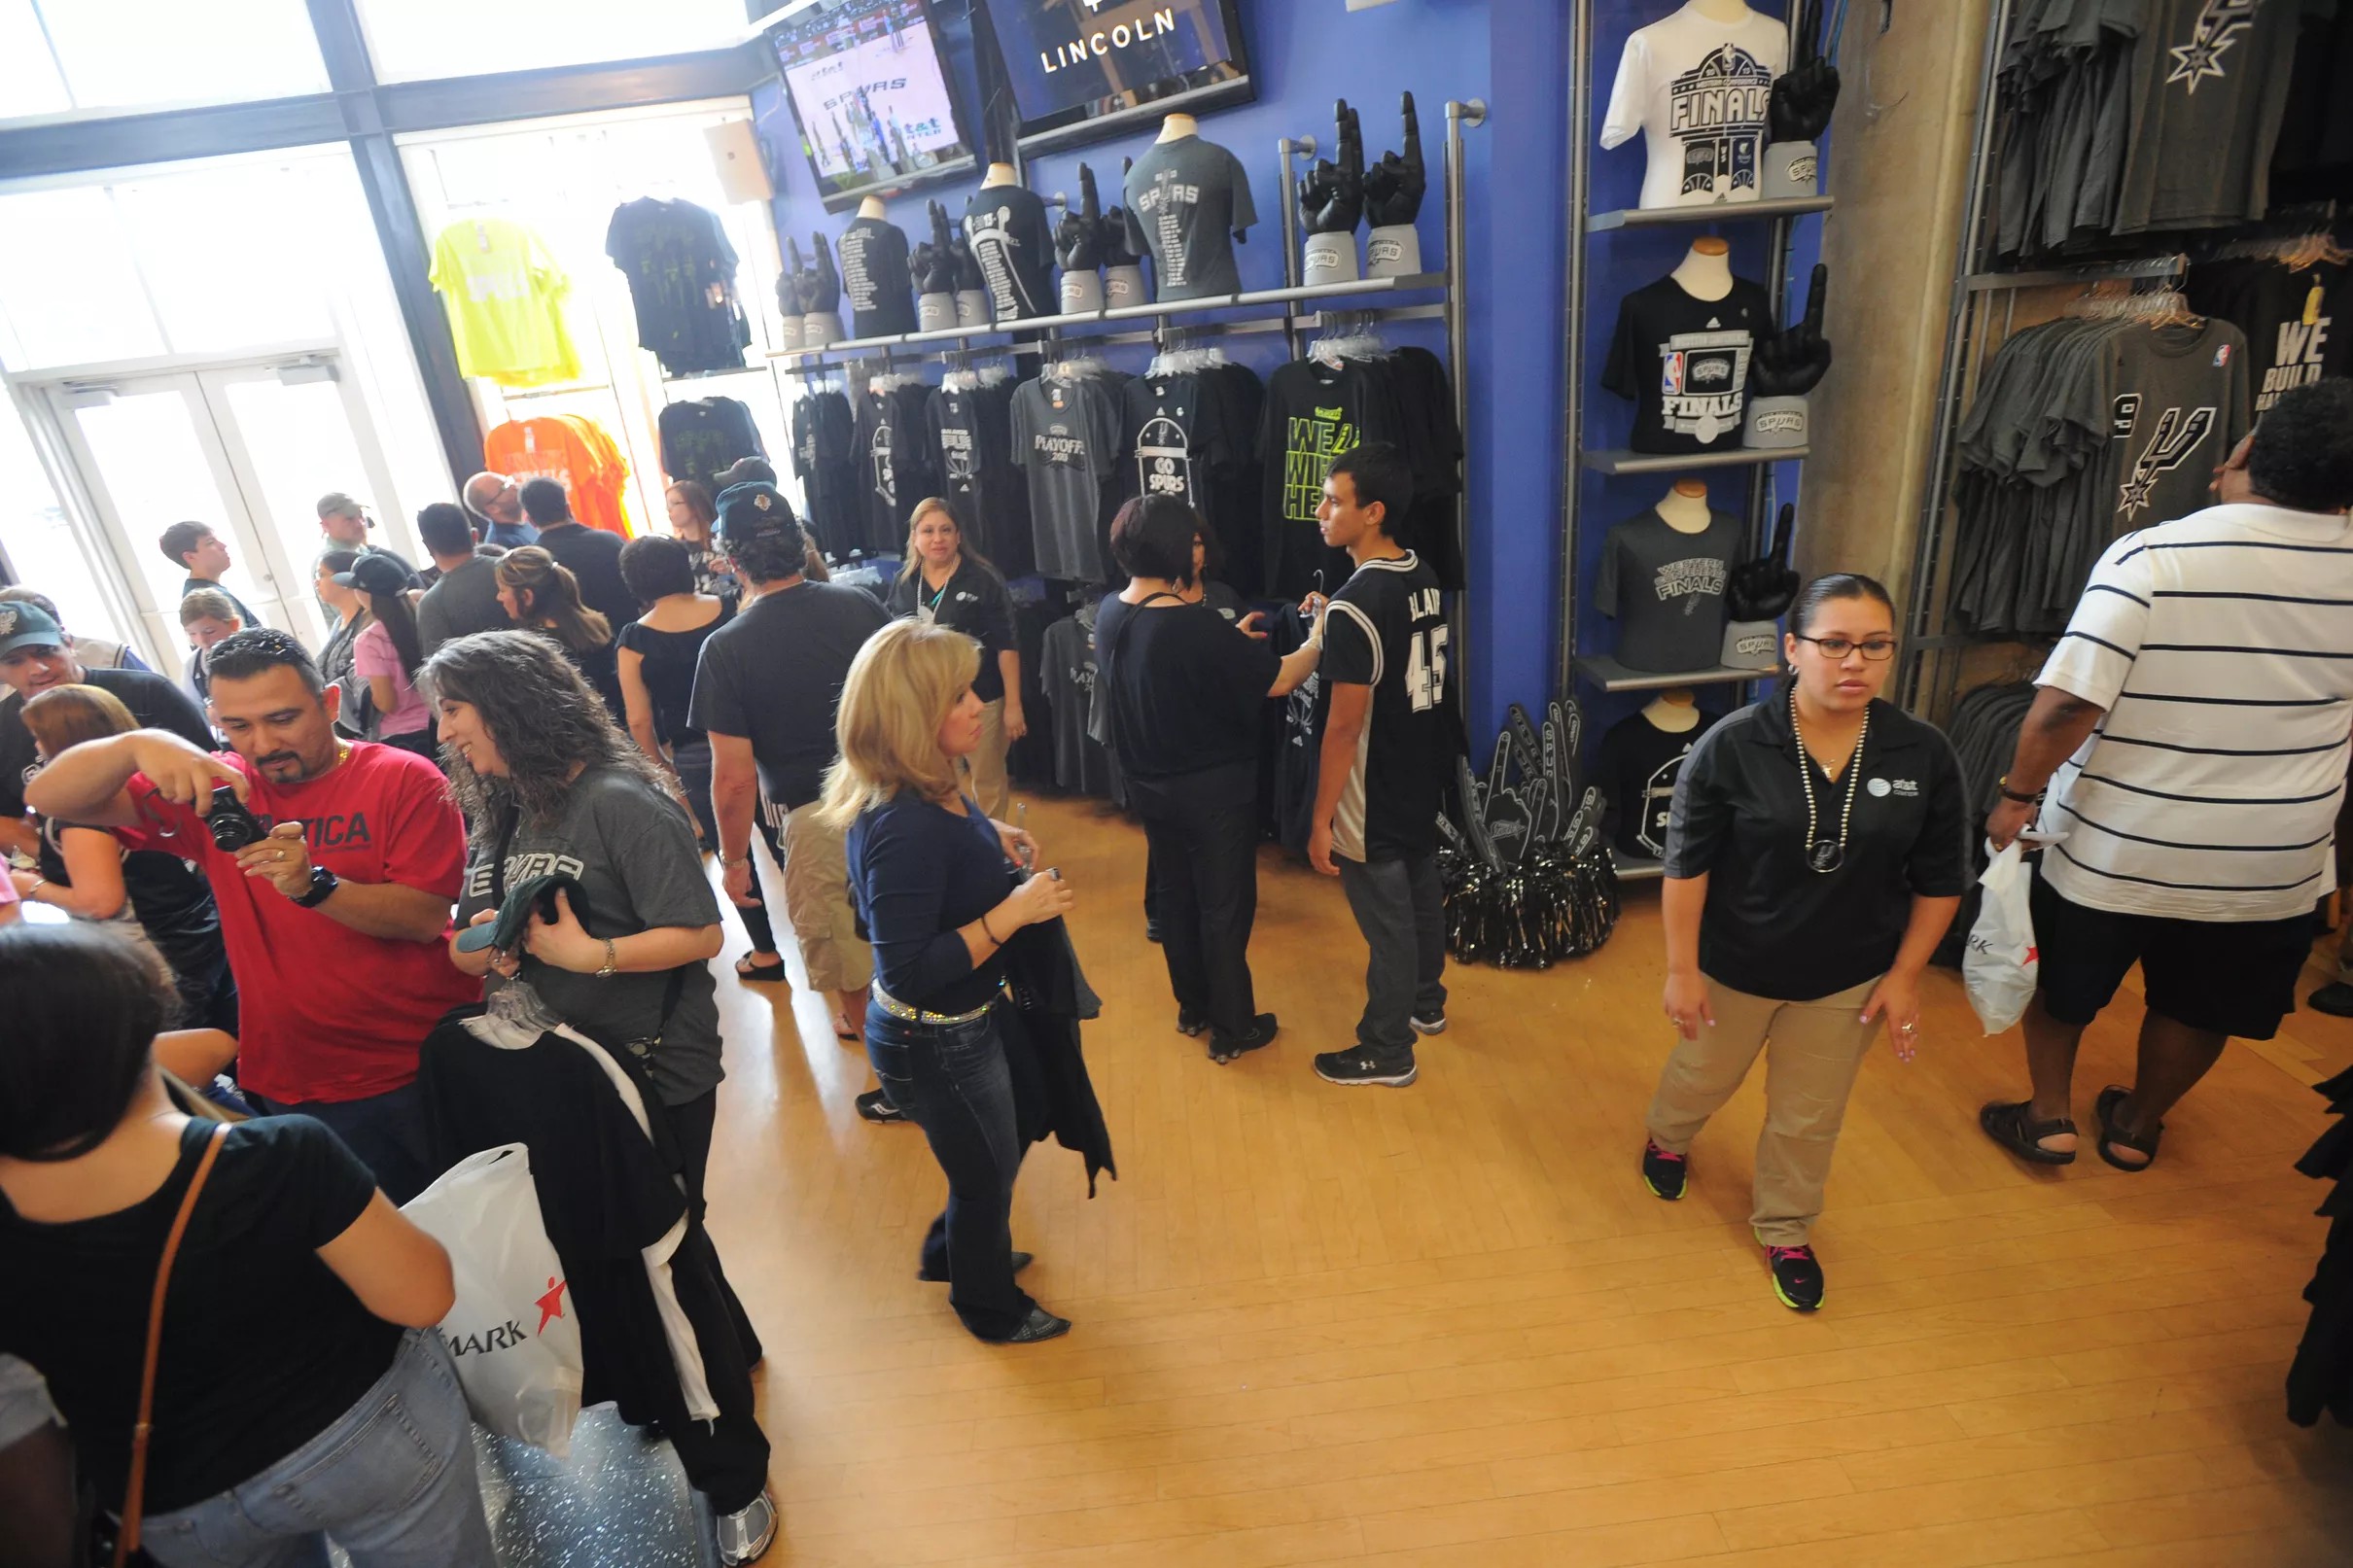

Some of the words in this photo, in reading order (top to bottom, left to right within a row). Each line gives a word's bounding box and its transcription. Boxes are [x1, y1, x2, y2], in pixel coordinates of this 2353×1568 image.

[1040, 8, 1176, 74] LINCOLN
[1670, 88, 1771, 131] FINALS
[2276, 317, 2332, 366] WE
[1662, 392, 1743, 418] FINALS
[1759, 415, 1802, 429] SPURS
[1035, 434, 1086, 455] PLAYOFF
[1154, 457, 1176, 475] GO
[1148, 472, 1185, 493] SPURS
[1657, 557, 1725, 575] WESTERN
[1656, 575, 1724, 601] FINALS
[1405, 623, 1448, 714] 45
[1545, 729, 1554, 778] SPUR
[441, 1320, 527, 1357] MARK
